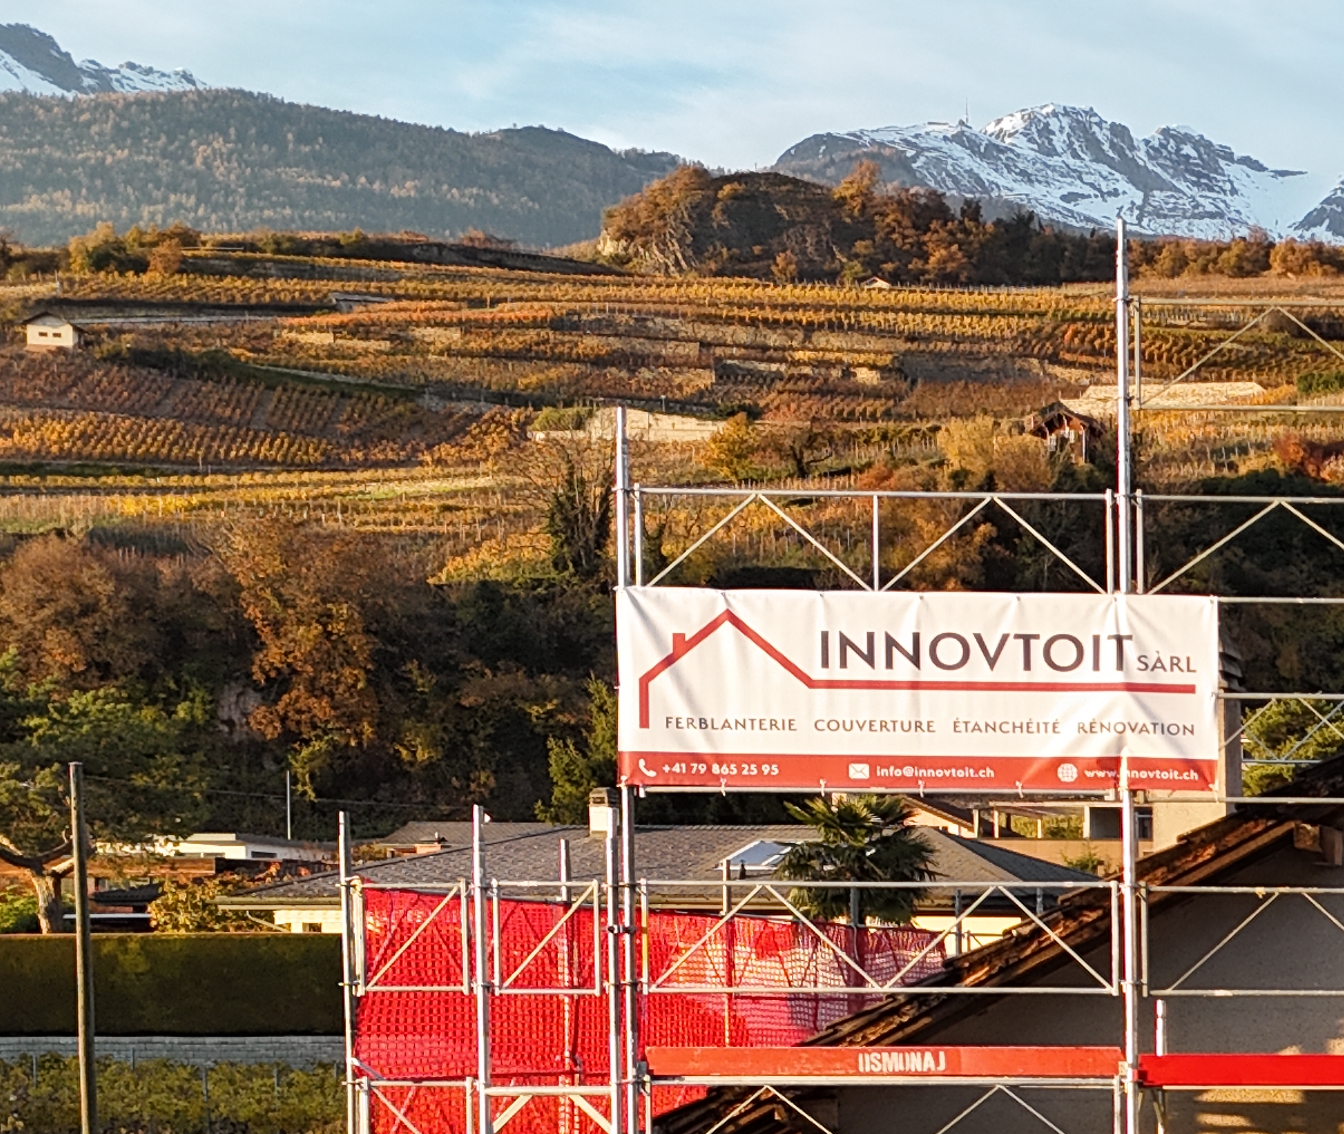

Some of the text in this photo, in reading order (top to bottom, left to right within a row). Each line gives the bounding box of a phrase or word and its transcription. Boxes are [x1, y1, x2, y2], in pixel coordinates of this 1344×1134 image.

[820, 630, 1197, 674] INNOVTOIT SÀRL
[665, 716, 1196, 736] FERBLANTERIE COUVERTURE ÉTANCHÉITÉ RÉNOVATION
[662, 763, 779, 777] +41 79 865 25 95
[876, 765, 995, 779] info@innovtoit.ch
[1084, 769, 1199, 781] www.nnovtoit.ch
